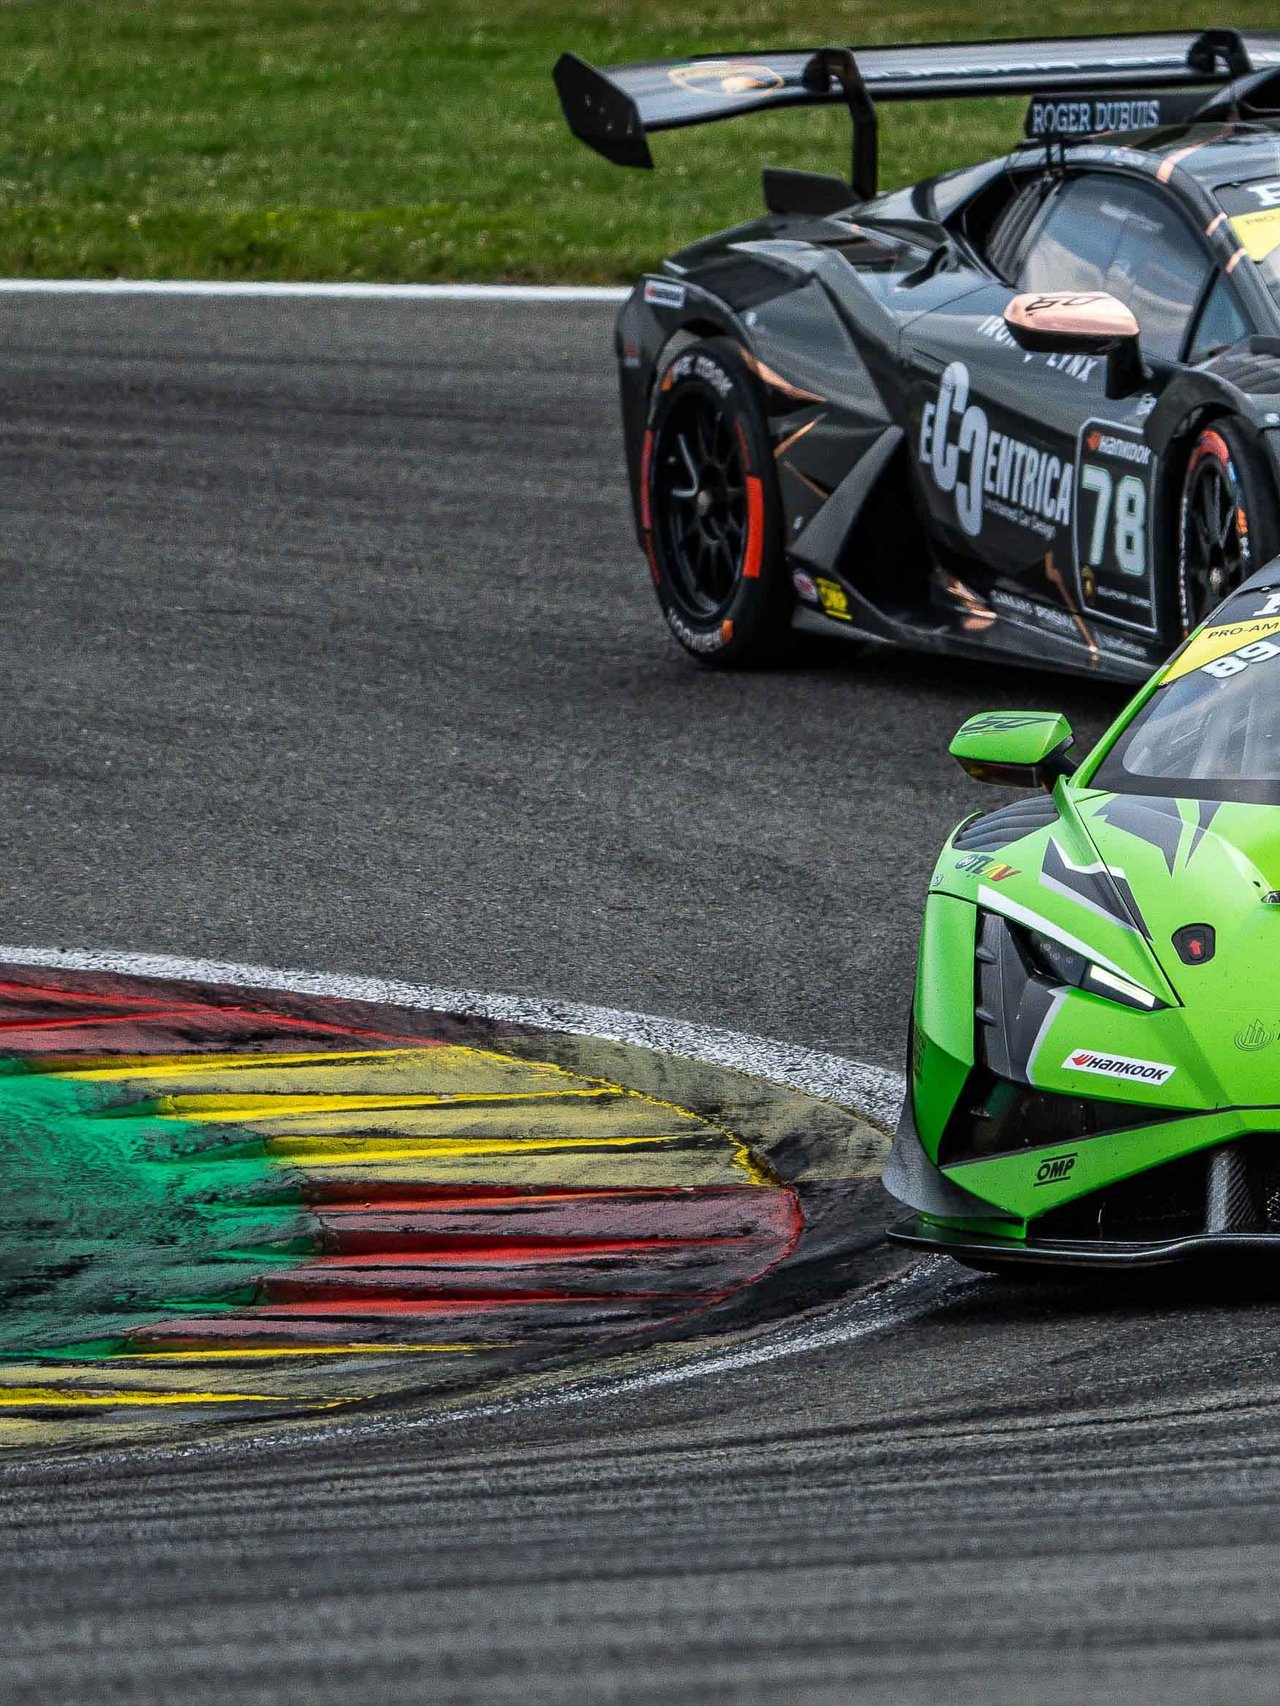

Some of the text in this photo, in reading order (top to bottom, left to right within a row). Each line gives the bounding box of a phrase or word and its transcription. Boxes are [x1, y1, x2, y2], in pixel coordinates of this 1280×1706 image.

[1032, 99, 1160, 134] ROGER DUBUIS
[1081, 463, 1147, 577] 78
[1206, 621, 1280, 640] PRO-AM
[1037, 1157, 1075, 1182] OMP
